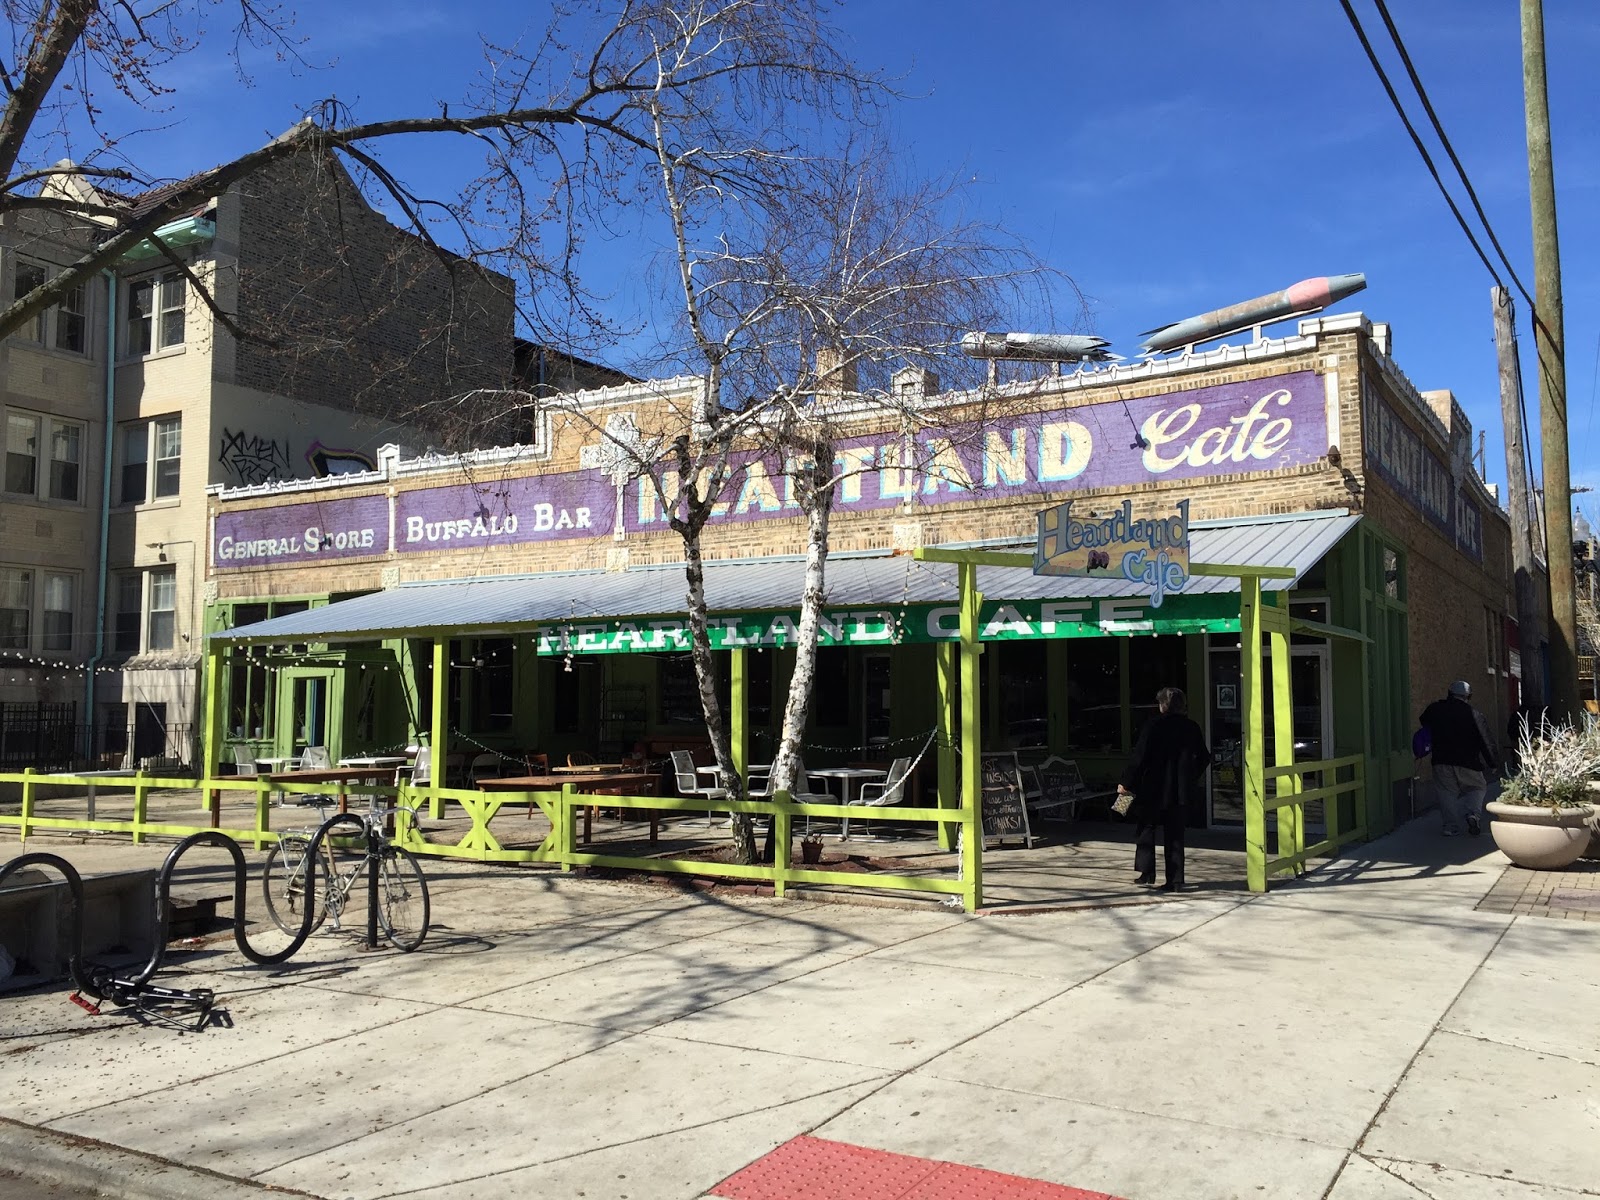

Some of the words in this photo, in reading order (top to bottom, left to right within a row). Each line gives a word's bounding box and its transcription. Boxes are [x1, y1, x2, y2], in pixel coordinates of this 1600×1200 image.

[1140, 388, 1293, 474] Cafe
[533, 503, 593, 532] BAR
[1034, 498, 1190, 570] Heartland
[1122, 548, 1186, 608] Cafe
[537, 610, 895, 651] HEARLAND
[925, 599, 1154, 637] CAFE
